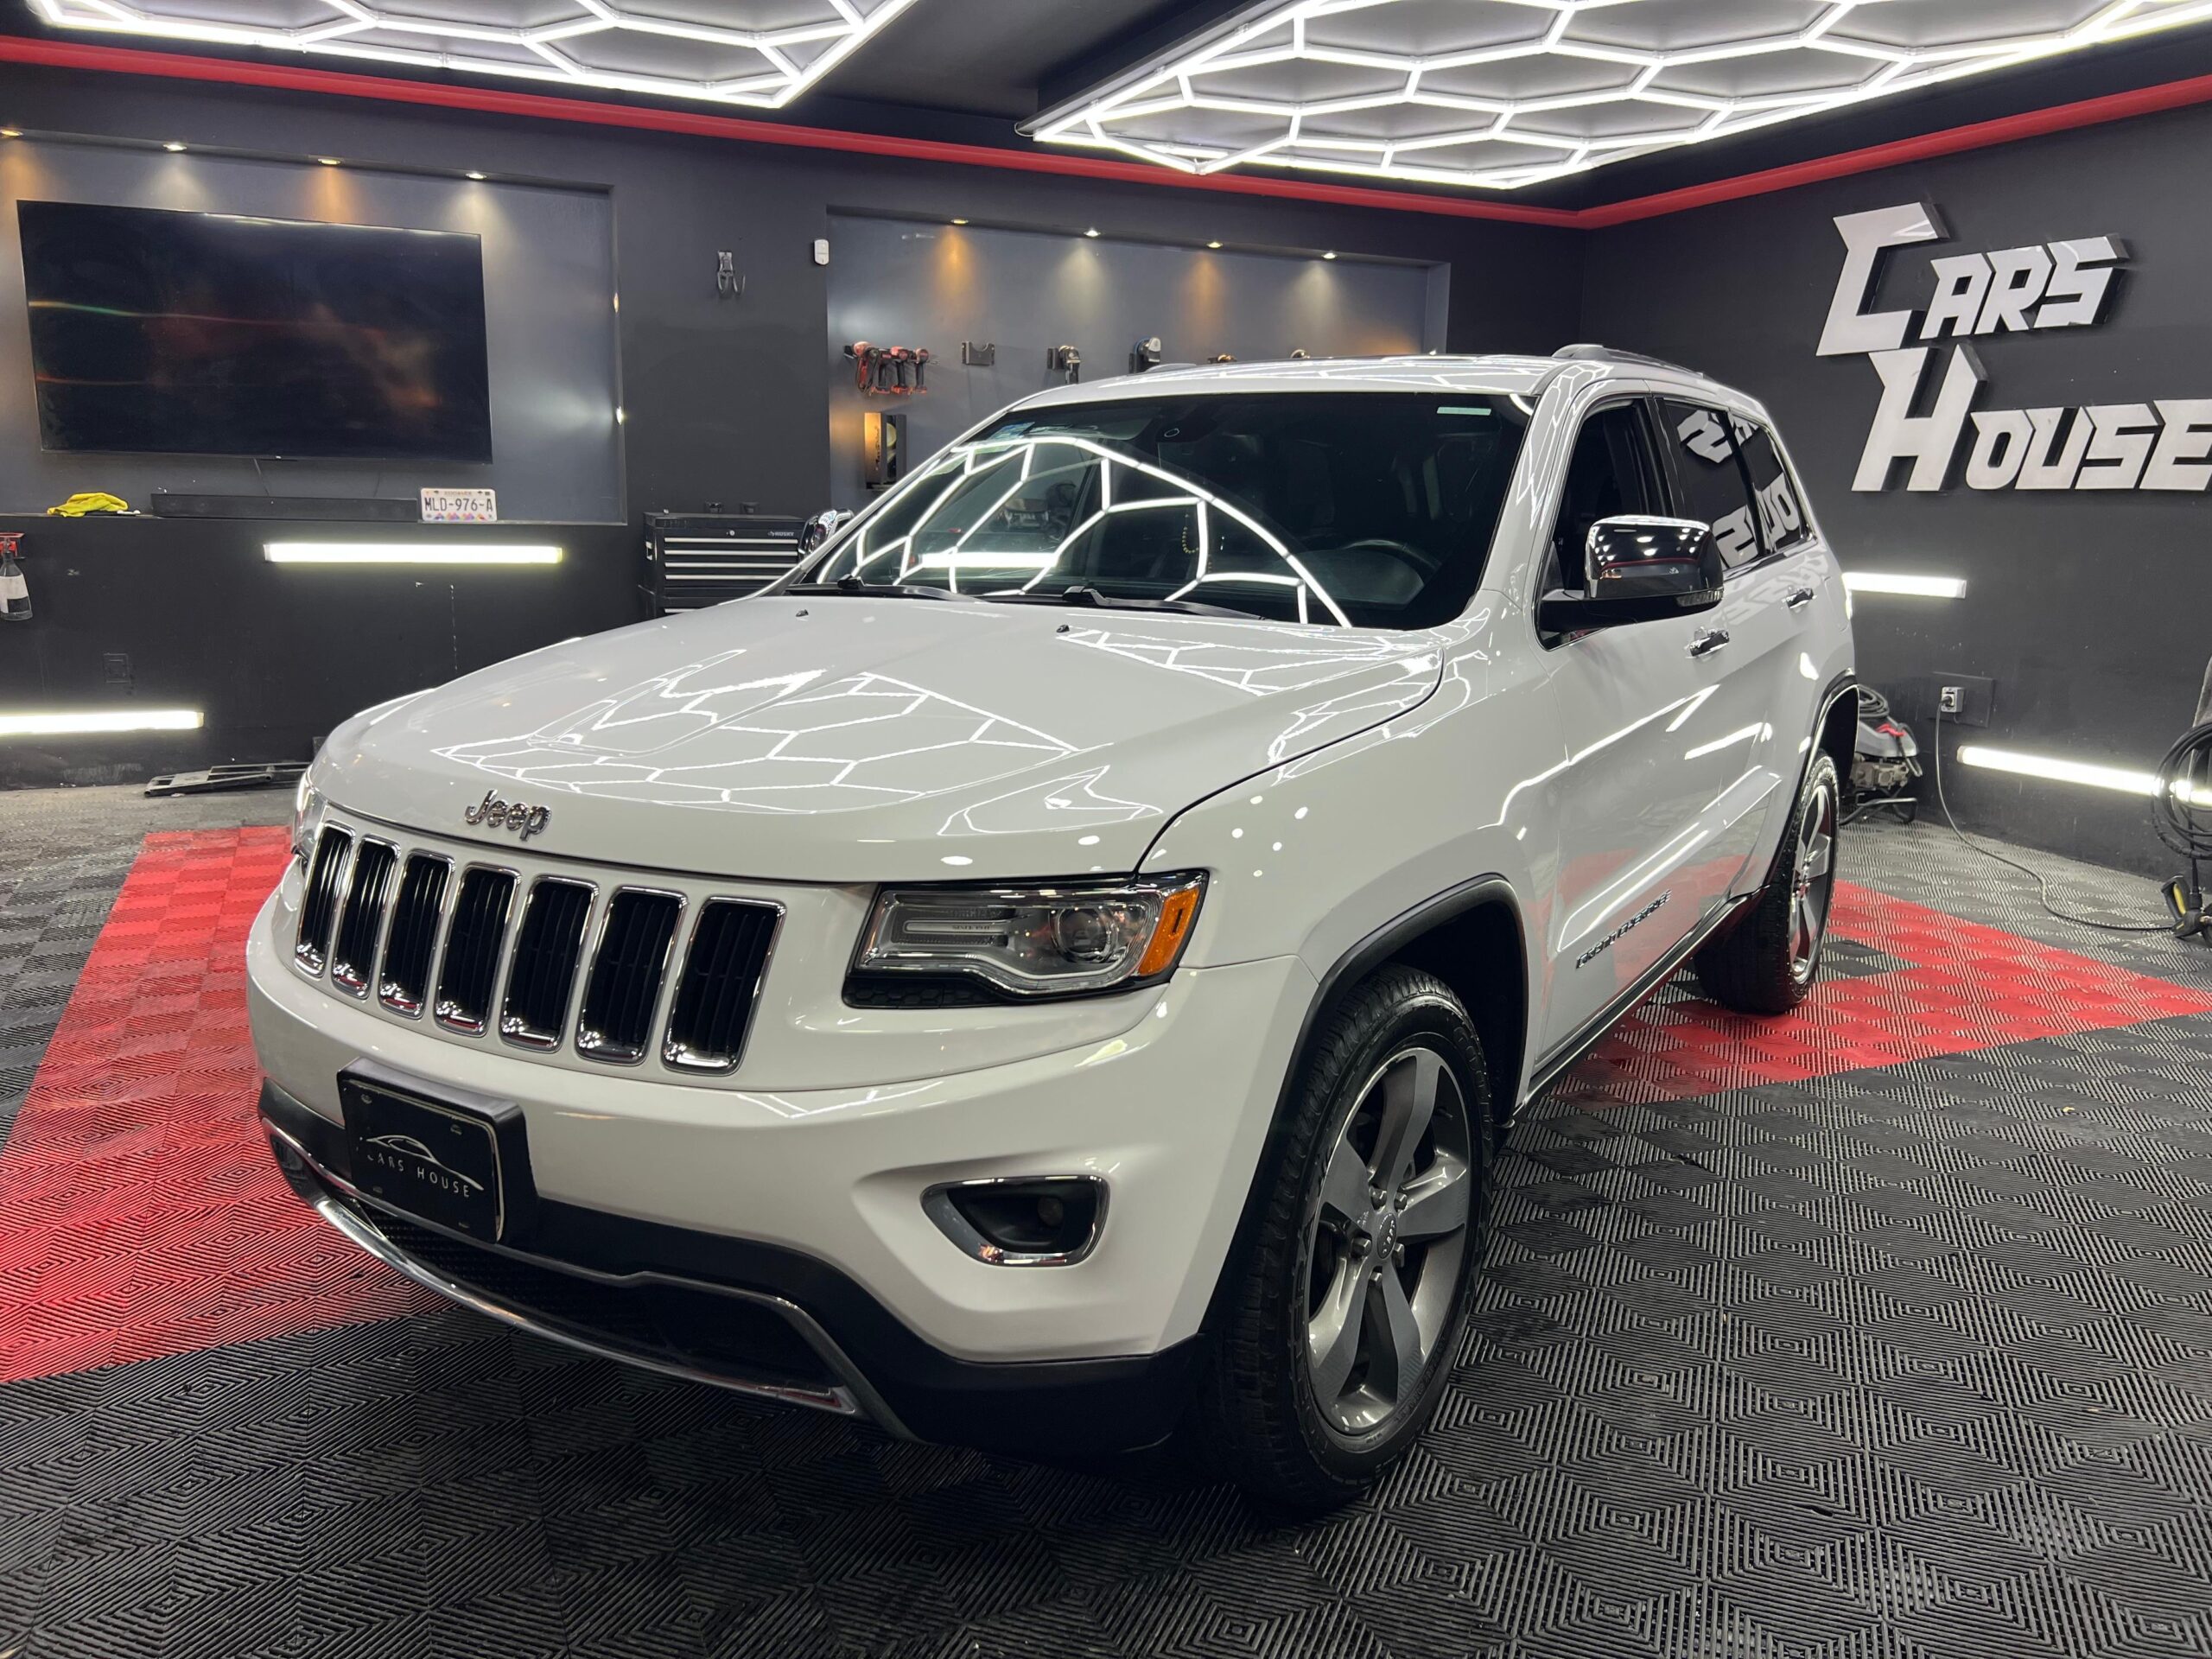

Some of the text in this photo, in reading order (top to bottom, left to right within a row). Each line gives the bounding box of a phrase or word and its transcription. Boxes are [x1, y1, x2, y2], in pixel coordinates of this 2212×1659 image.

[1816, 202, 2124, 356] CARS
[1851, 344, 2212, 492] HOUSE
[424, 497, 493, 512] MLD-976-A
[465, 789, 552, 842] Jeep
[416, 1166, 470, 1198] HOUSE
